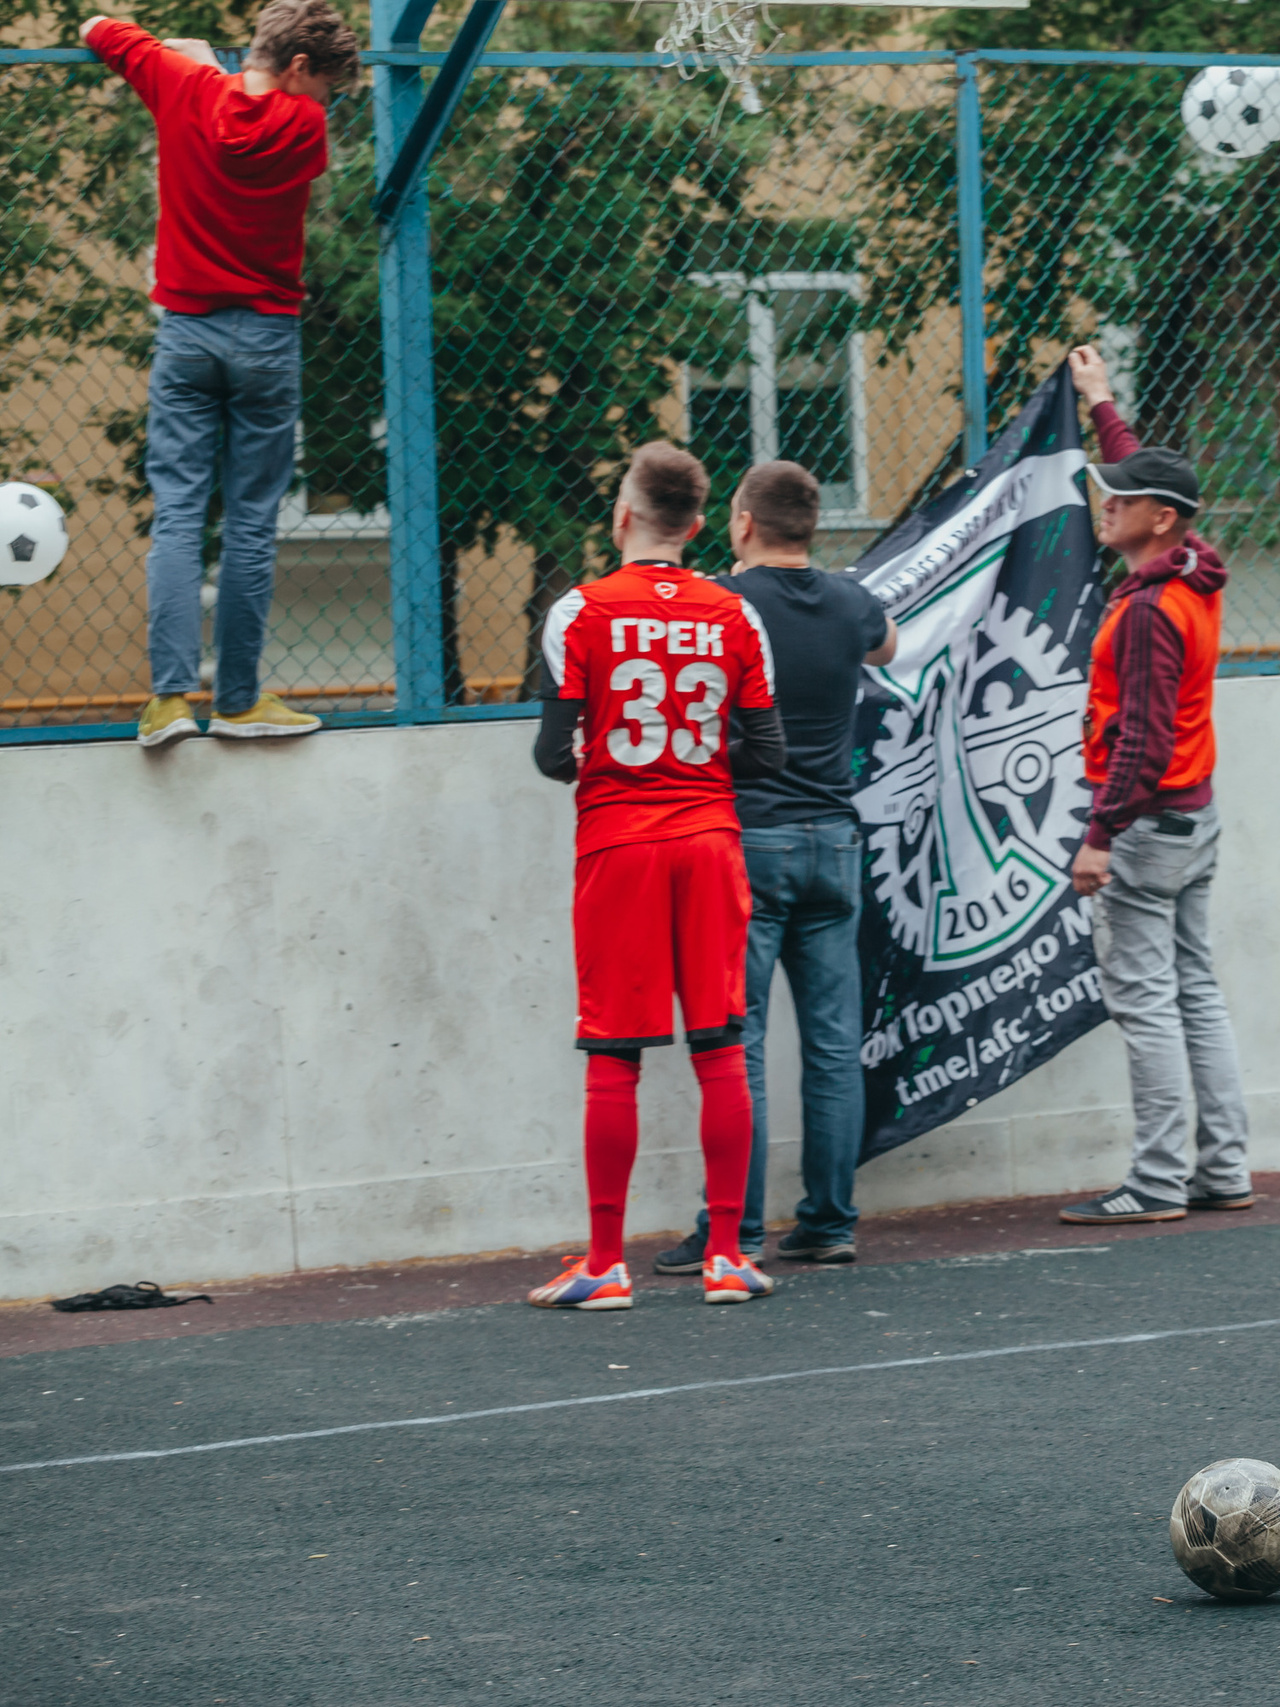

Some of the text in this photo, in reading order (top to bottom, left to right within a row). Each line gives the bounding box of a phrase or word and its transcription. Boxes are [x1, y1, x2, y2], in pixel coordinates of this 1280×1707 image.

[610, 617, 725, 657] ГРЕК
[606, 658, 729, 766] 33
[944, 876, 1030, 940] 2016
[860, 1016, 904, 1069] ФК
[901, 934, 1060, 1043] Торпедо
